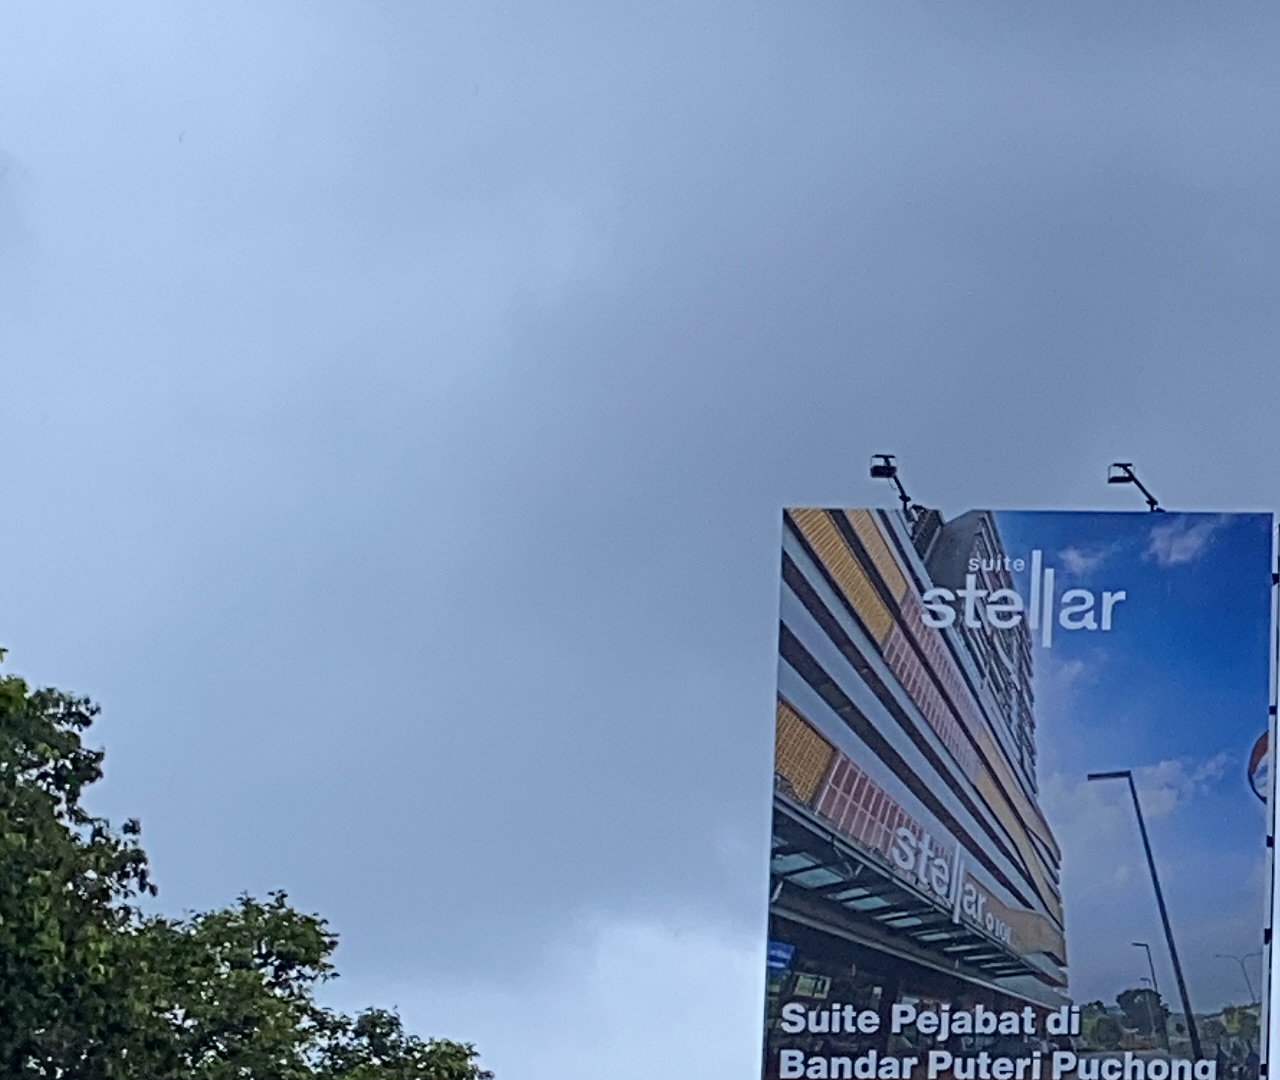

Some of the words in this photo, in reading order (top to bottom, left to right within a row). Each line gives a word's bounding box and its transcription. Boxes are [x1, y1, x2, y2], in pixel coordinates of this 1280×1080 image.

[968, 556, 1026, 572] suite
[921, 549, 1127, 649] stellar
[892, 826, 987, 924] stellar
[780, 1002, 880, 1034] Suite
[891, 1003, 1036, 1041] Pejabat
[1046, 1005, 1081, 1035] di
[779, 1049, 918, 1080] Bandar
[927, 1050, 1041, 1080] Puteri
